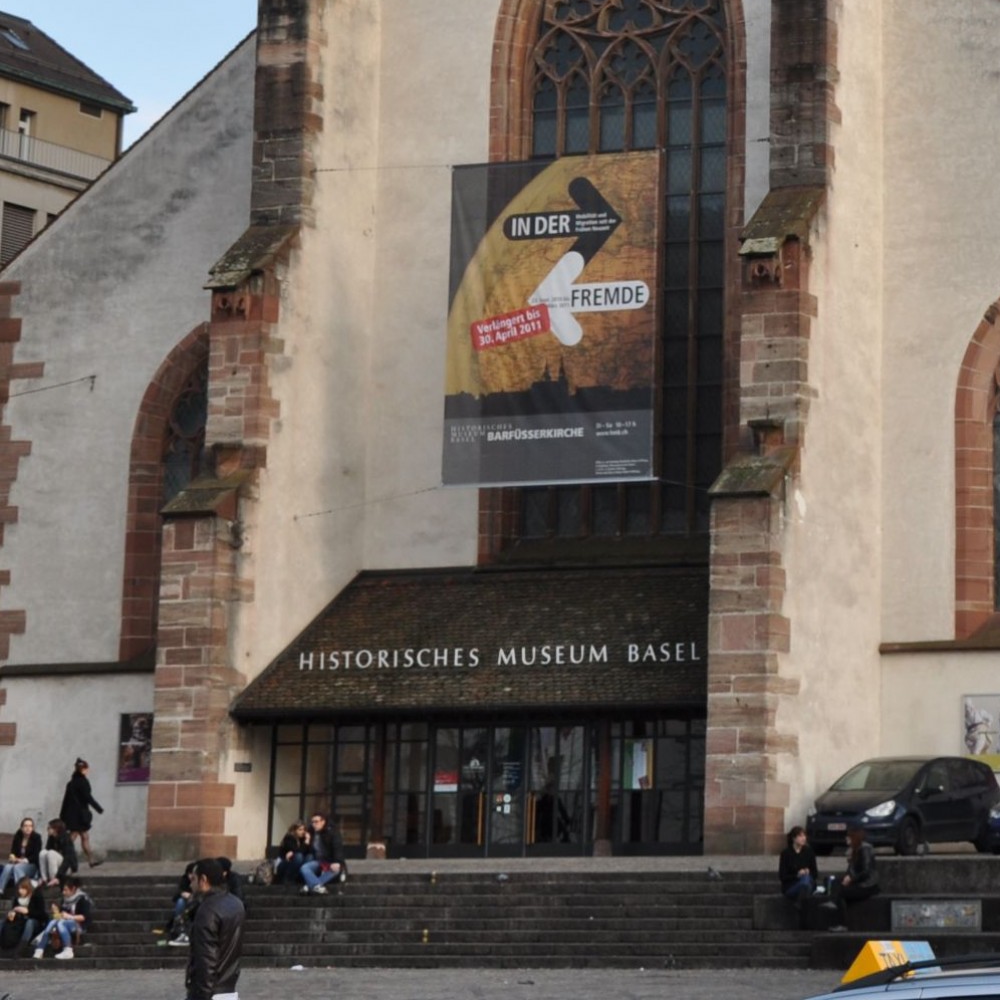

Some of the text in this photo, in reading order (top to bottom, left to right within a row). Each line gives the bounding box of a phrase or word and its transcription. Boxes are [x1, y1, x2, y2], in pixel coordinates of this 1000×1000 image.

[511, 214, 570, 237] IN DER
[571, 285, 645, 307] FREMDE
[476, 309, 541, 334] Verlängert bis
[479, 320, 542, 346] 30. April 2011
[487, 426, 585, 441] BARFÜSSERKIRCHE
[299, 642, 700, 670] HISTORISCHES MUSEUM BASEL
